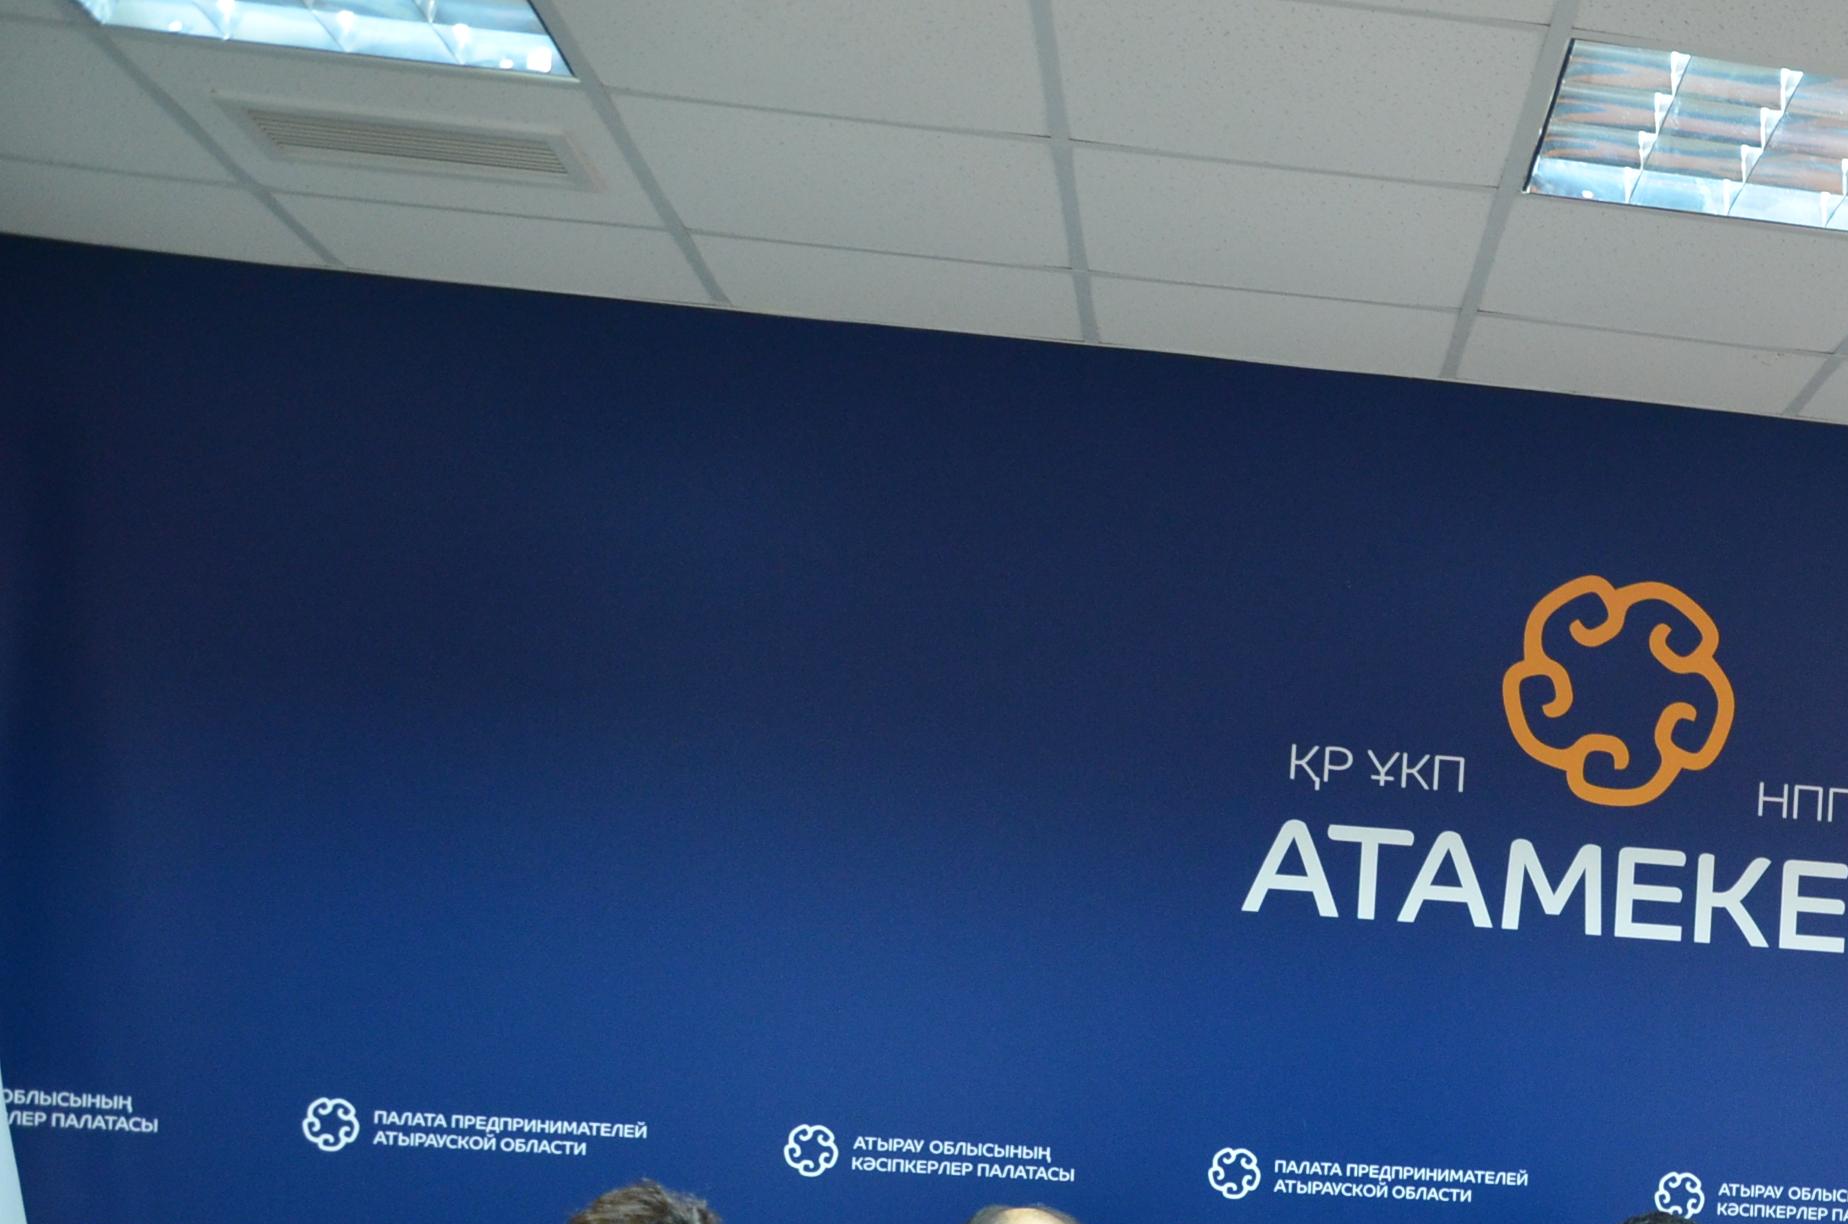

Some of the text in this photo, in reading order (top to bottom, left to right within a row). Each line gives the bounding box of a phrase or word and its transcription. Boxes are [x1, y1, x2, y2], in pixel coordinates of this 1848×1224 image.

[1289, 744, 1466, 793] ҚР ҰКП
[51, 1112, 159, 1133] ПАЛАТАСЫ
[373, 1110, 648, 1139] ПАЛАТА ПРЕДПРИНИМАТЕЛЕЙ
[372, 1130, 587, 1156] АТЫРАУСКОЙ ОБЛАСТИ
[853, 1135, 1052, 1163] АТЫРАУ ОБЛЫСЫНЫҢ
[851, 1156, 1075, 1182] КӘСІПКЕРЛЕР ПАЛАТАСЫ
[1274, 1159, 1529, 1186] ПАЛАТА ПРЕДПРИНИМАТЕЛЕЙ
[1273, 1179, 1472, 1202] АТЫРАУСКОЙ ОБЛАСТИ
[1718, 1182, 1784, 1199] АТЫРАУ
[1716, 1202, 1828, 1221] КӘСІПКЕРЛЕР
